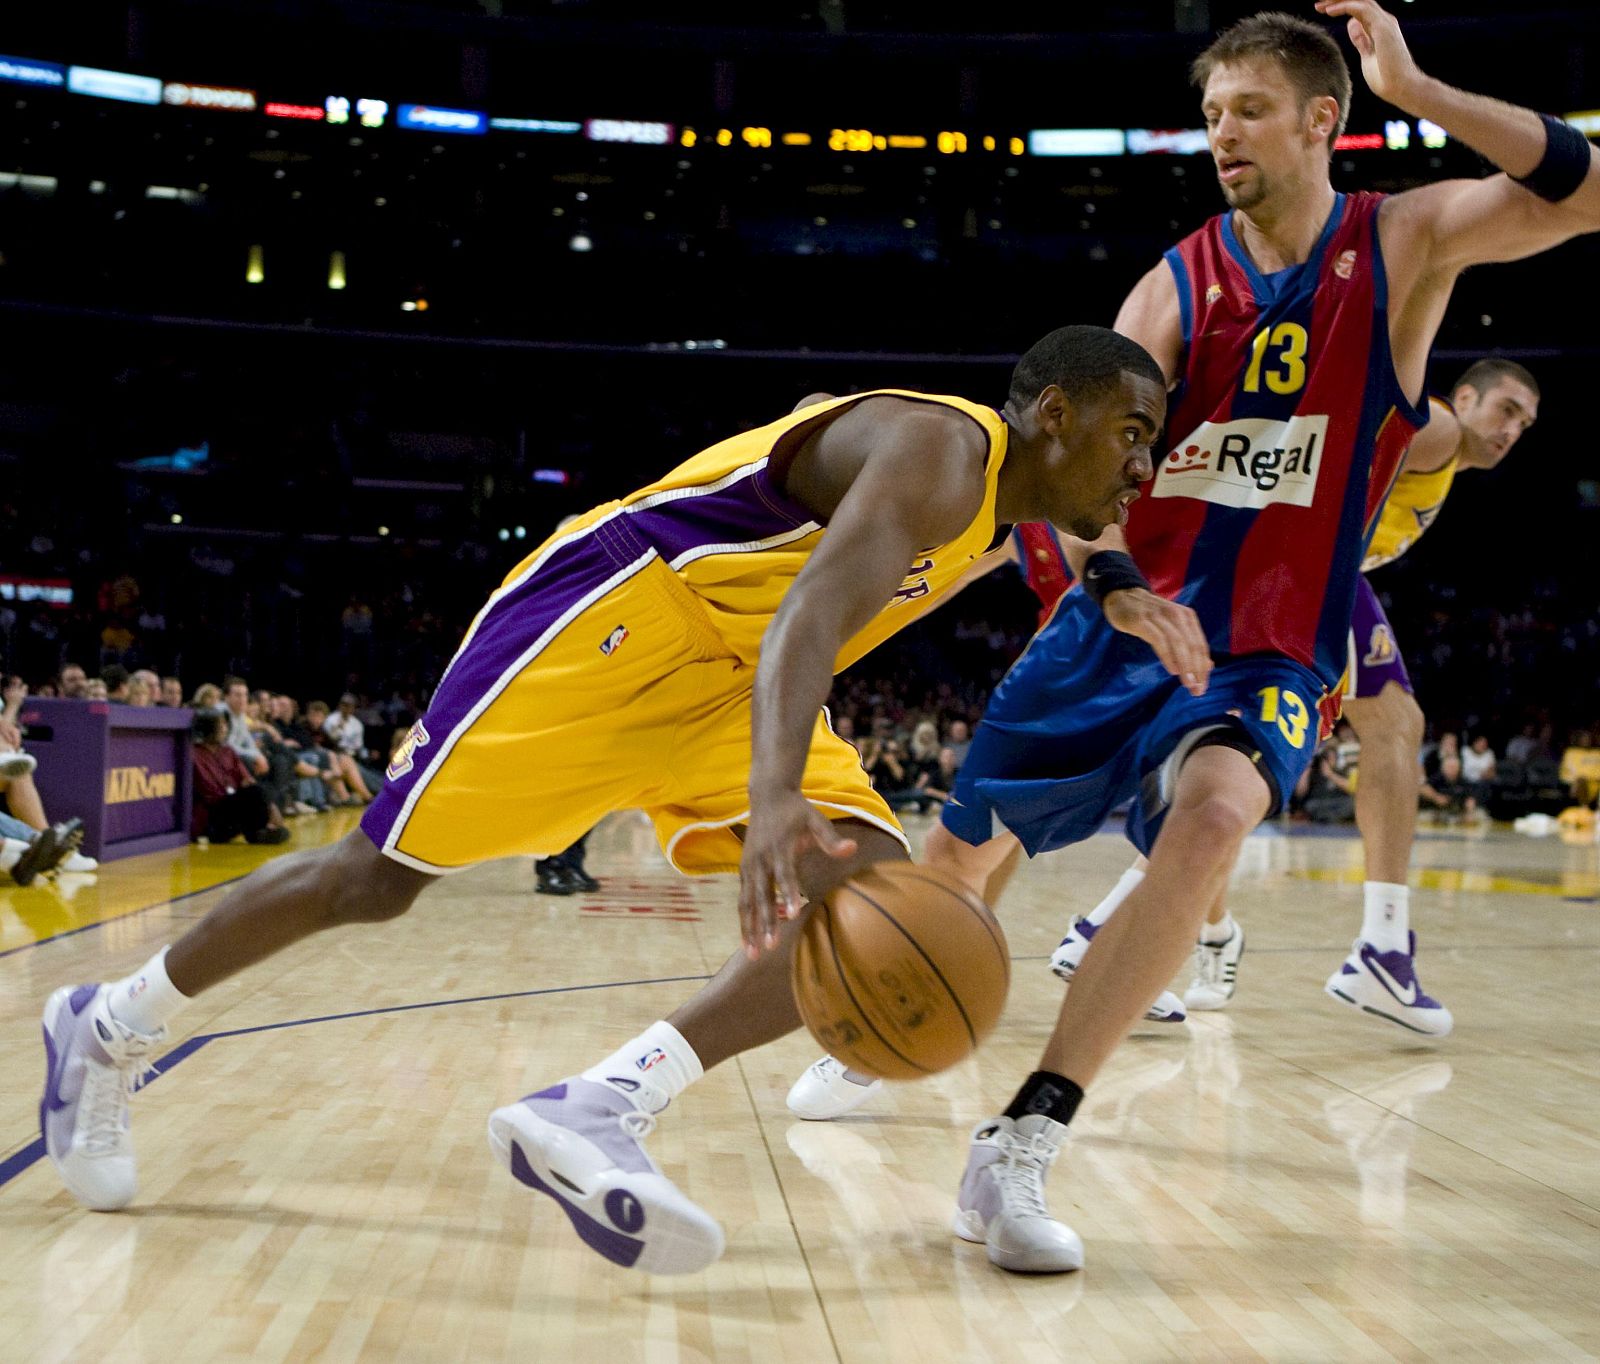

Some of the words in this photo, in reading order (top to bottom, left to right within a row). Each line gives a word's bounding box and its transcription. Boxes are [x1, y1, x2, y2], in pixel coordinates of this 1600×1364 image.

[1243, 322, 1308, 395] 13
[1216, 432, 1317, 491] Regal
[1256, 686, 1310, 750] 13
